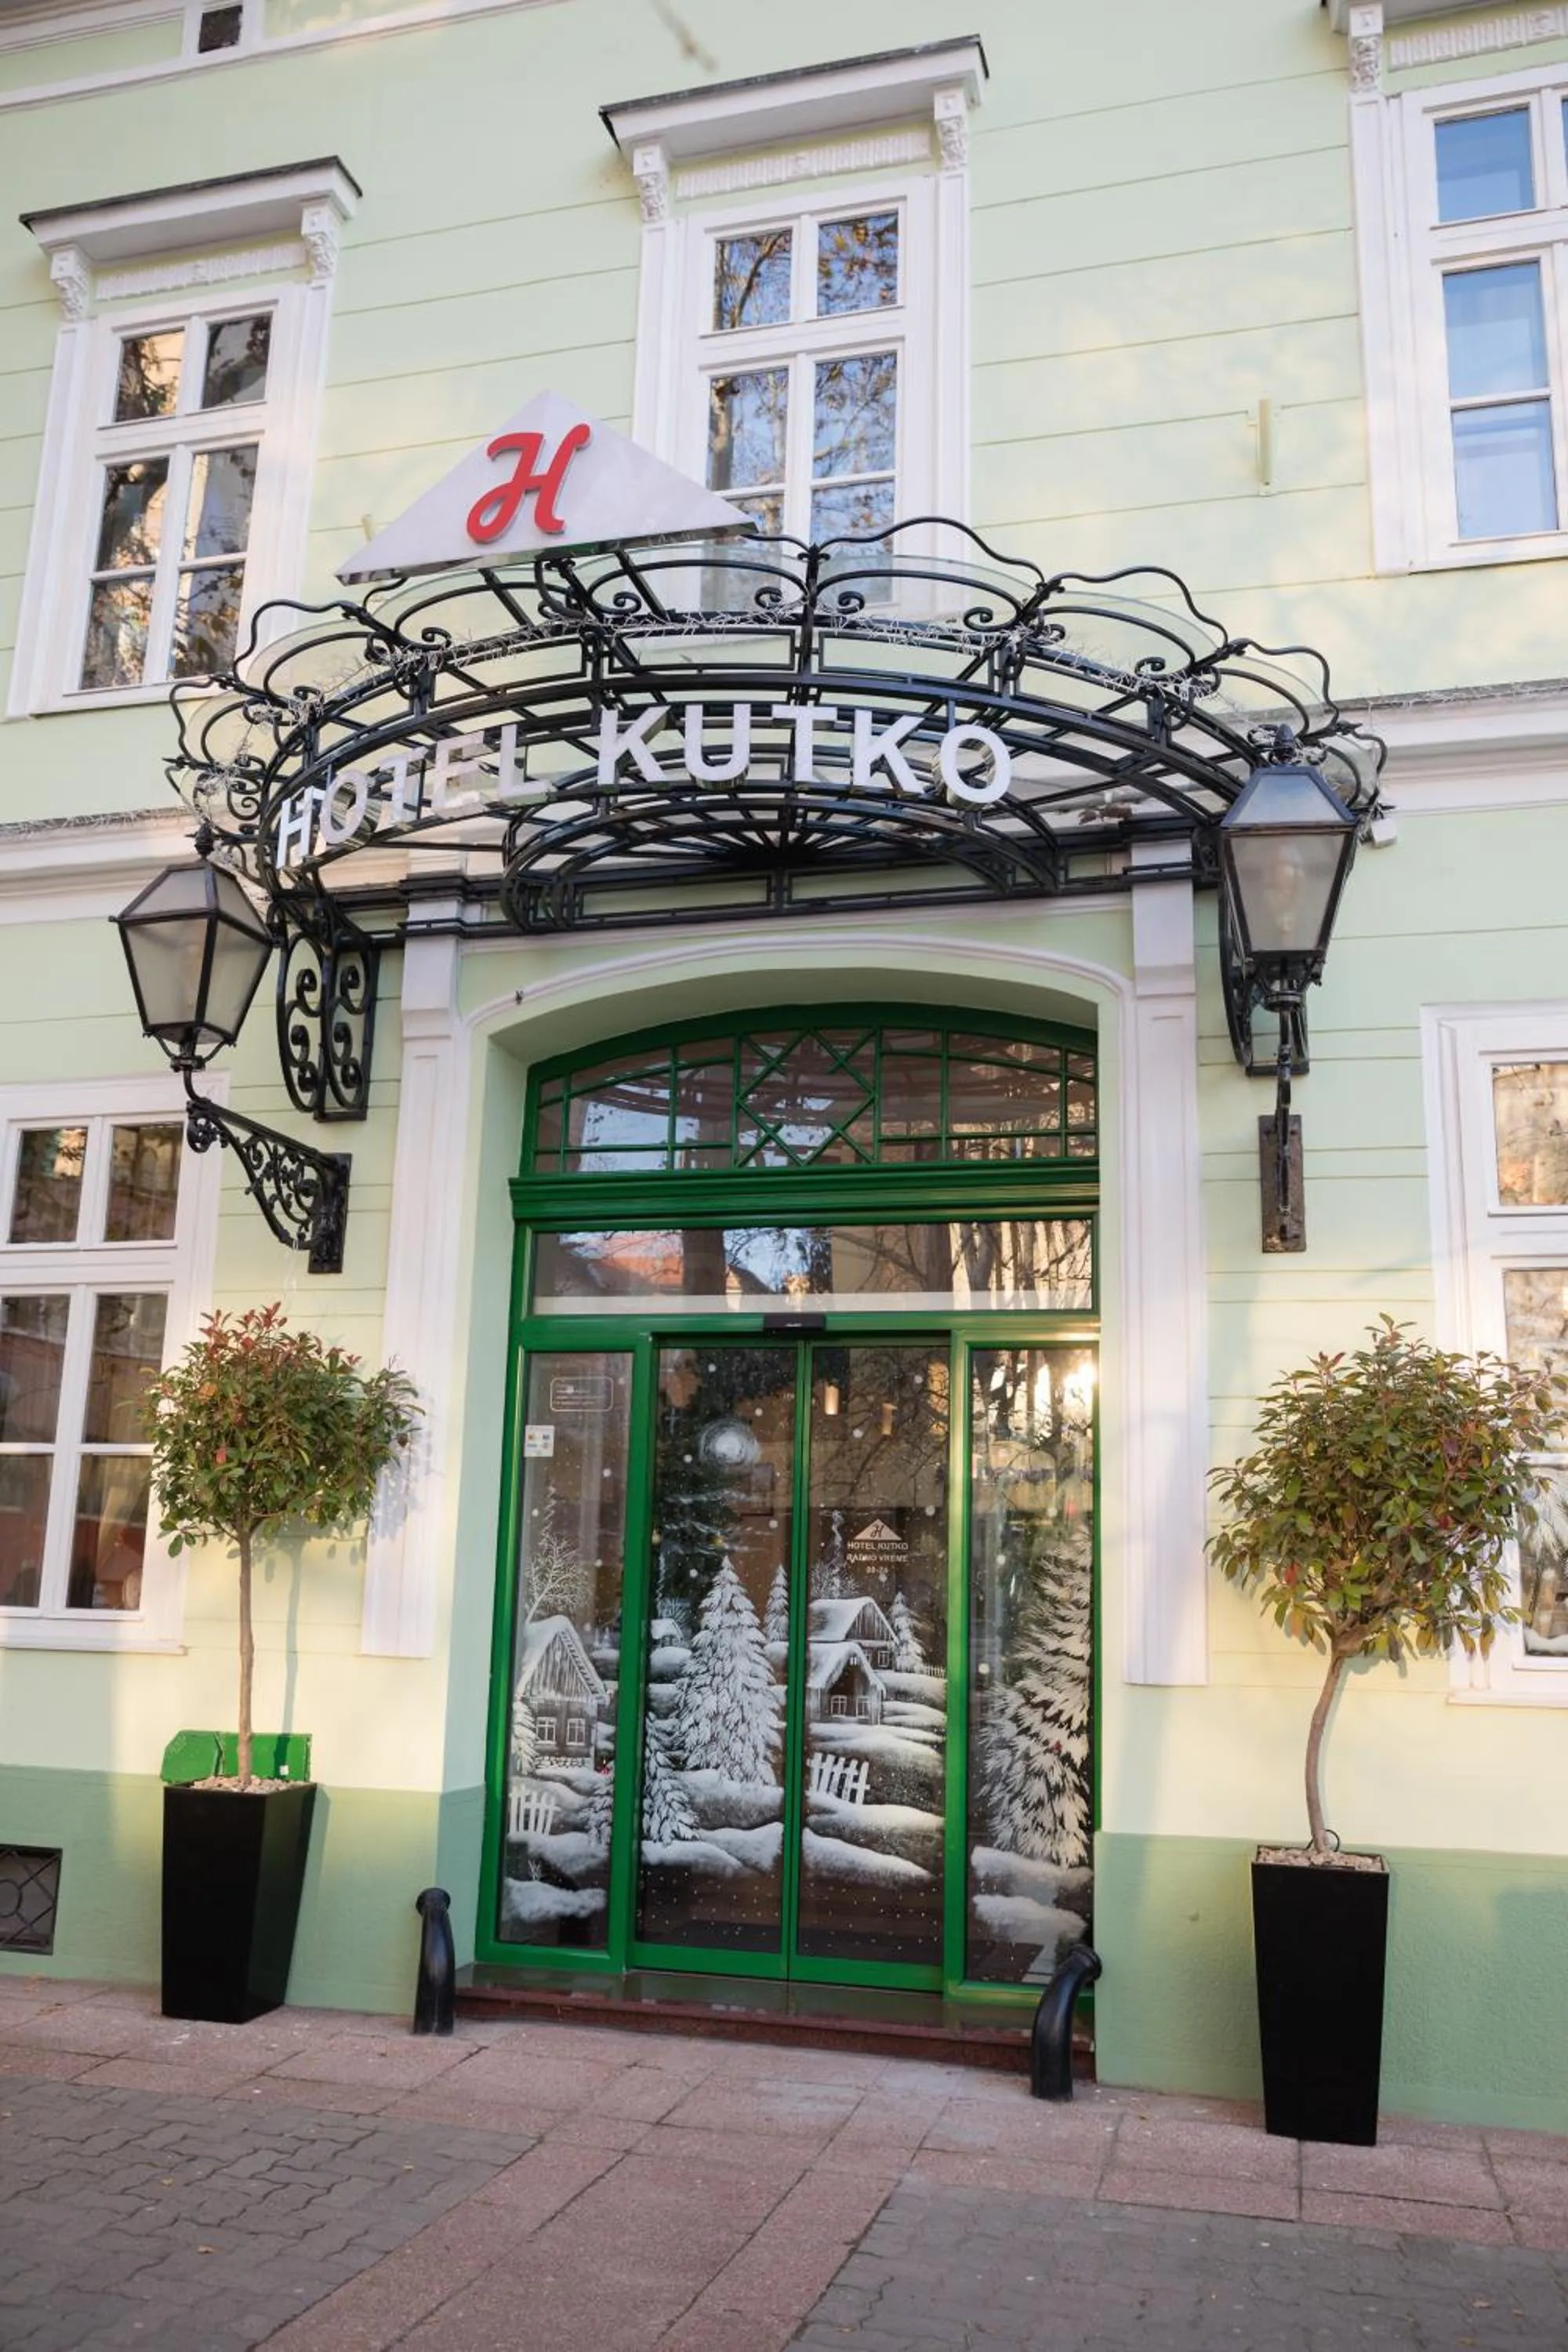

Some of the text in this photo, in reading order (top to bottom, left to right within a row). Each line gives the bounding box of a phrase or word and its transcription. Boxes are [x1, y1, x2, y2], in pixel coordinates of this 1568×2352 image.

[466, 423, 590, 543] H
[276, 703, 1013, 869] HOTEL KUTKO
